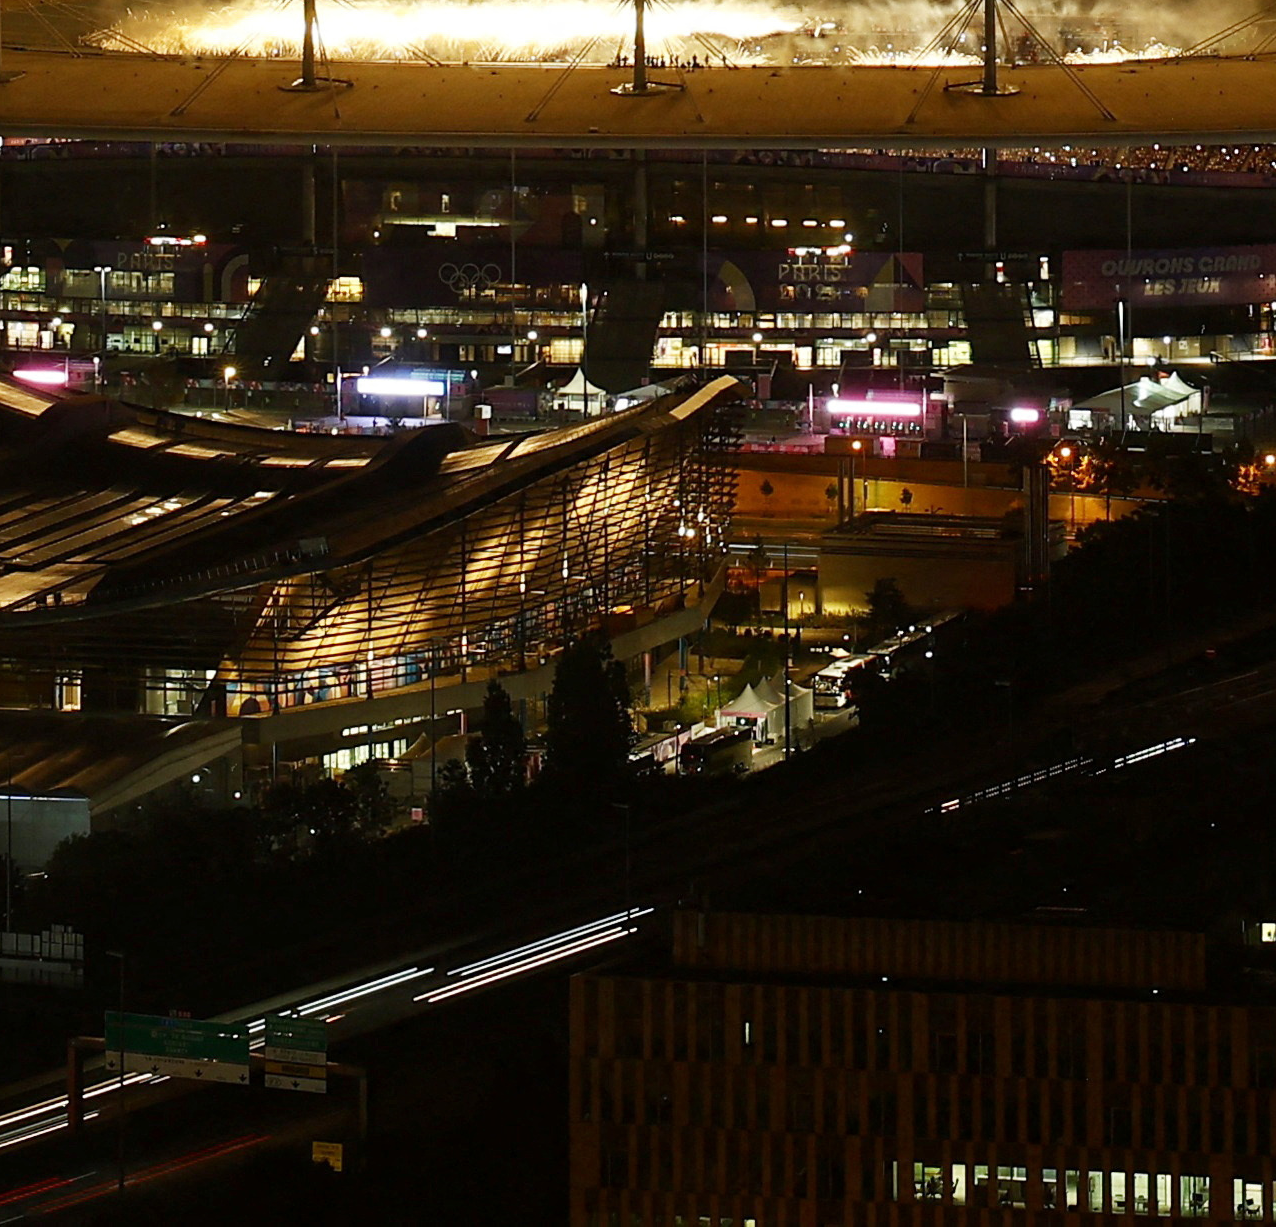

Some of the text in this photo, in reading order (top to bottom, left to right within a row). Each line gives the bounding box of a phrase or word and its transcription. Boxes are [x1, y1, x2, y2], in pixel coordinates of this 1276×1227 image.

[778, 263, 841, 282] PARIS
[1101, 255, 1262, 276] OUVRONS GRAND
[1144, 278, 1176, 295] LES
